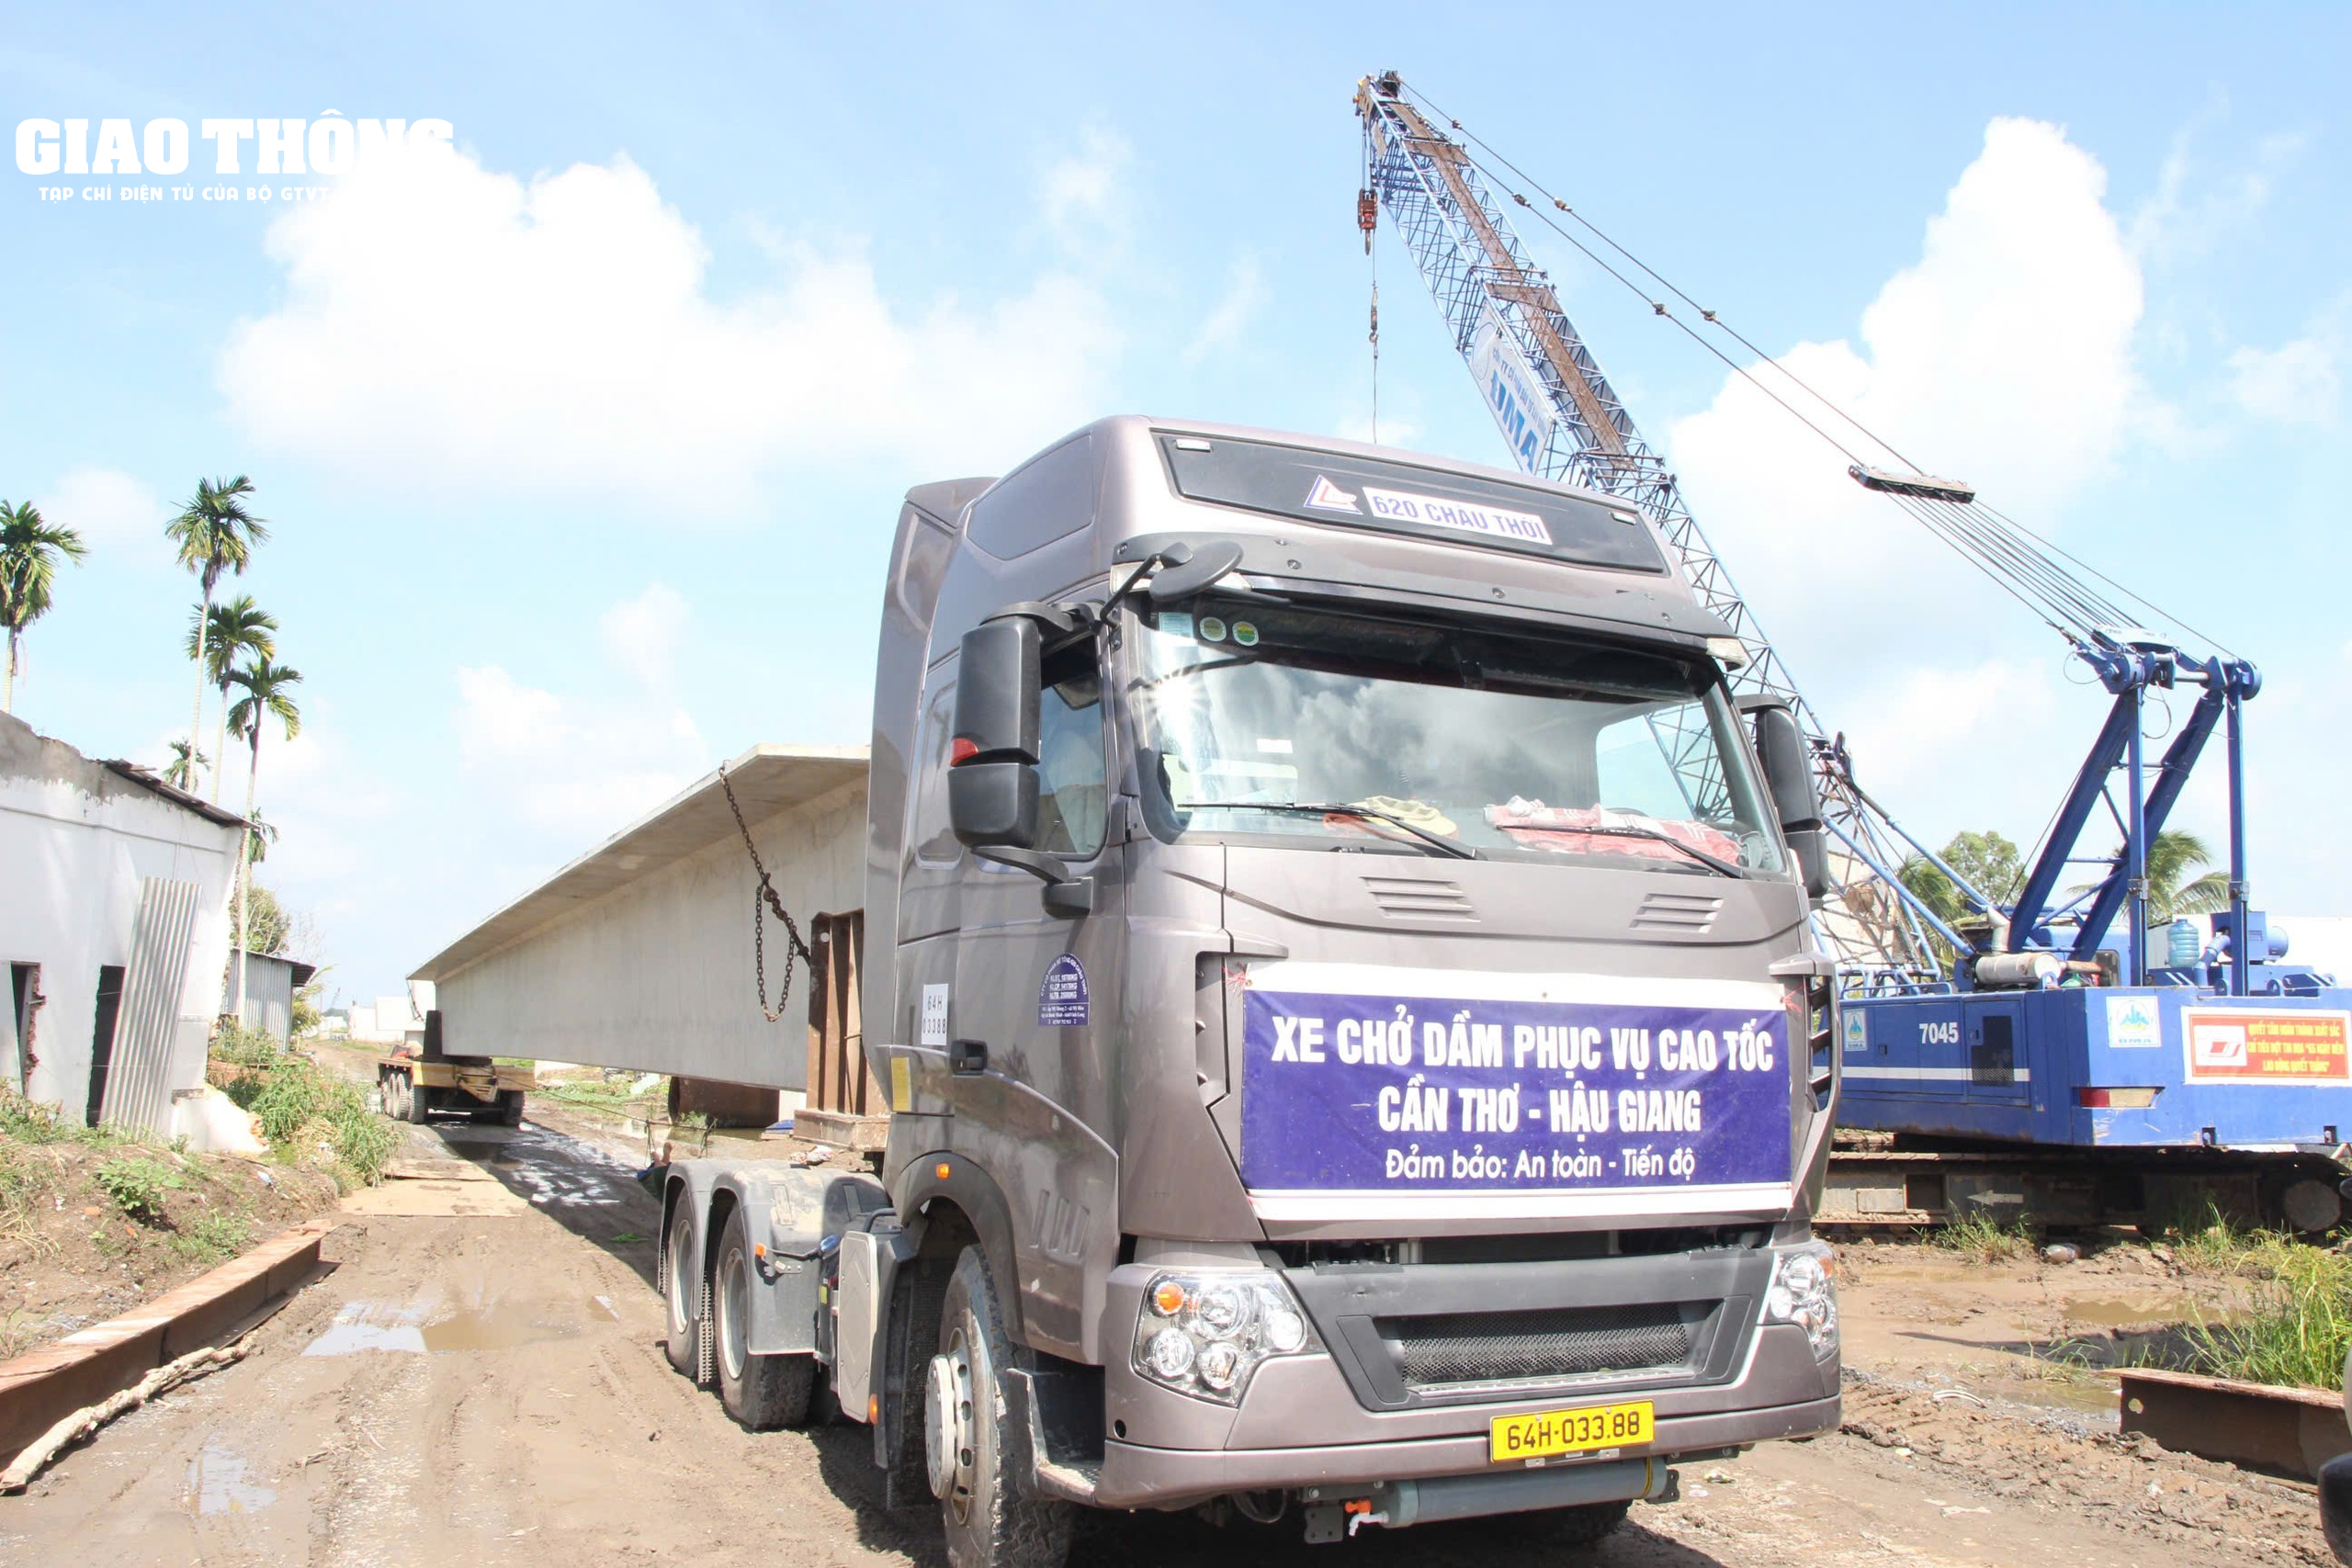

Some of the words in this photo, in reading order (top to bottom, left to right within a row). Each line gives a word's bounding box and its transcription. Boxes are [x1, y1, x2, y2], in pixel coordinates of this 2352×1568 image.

[1373, 495, 1419, 518] 620
[928, 995, 943, 1010] 64H
[922, 1018, 946, 1034] 03388
[1919, 1022, 1959, 1044] 7045
[1272, 1016, 1326, 1063] XE
[1337, 1004, 1414, 1065] CHỞ
[1424, 1010, 1502, 1067] DẦM
[1514, 1025, 1601, 1078] PHỤC
[1611, 1028, 1650, 1079] VỤ
[1658, 1029, 1717, 1071] CAO
[1723, 1018, 1773, 1071] TỐC
[1378, 1074, 1448, 1132] CẦN
[1459, 1083, 1520, 1133] THƠ
[1529, 1109, 1541, 1118] -
[1550, 1080, 1610, 1142] HẬU
[1618, 1089, 1701, 1133] GIANG
[1385, 1144, 1444, 1179] Đảm
[1453, 1145, 1507, 1179] bảo:
[1514, 1150, 1544, 1178] An
[1552, 1148, 1601, 1178] toàn
[1623, 1145, 1663, 1177] Tiến
[1668, 1147, 1695, 1180] độ
[1508, 1411, 1640, 1450] 64H-033.88
